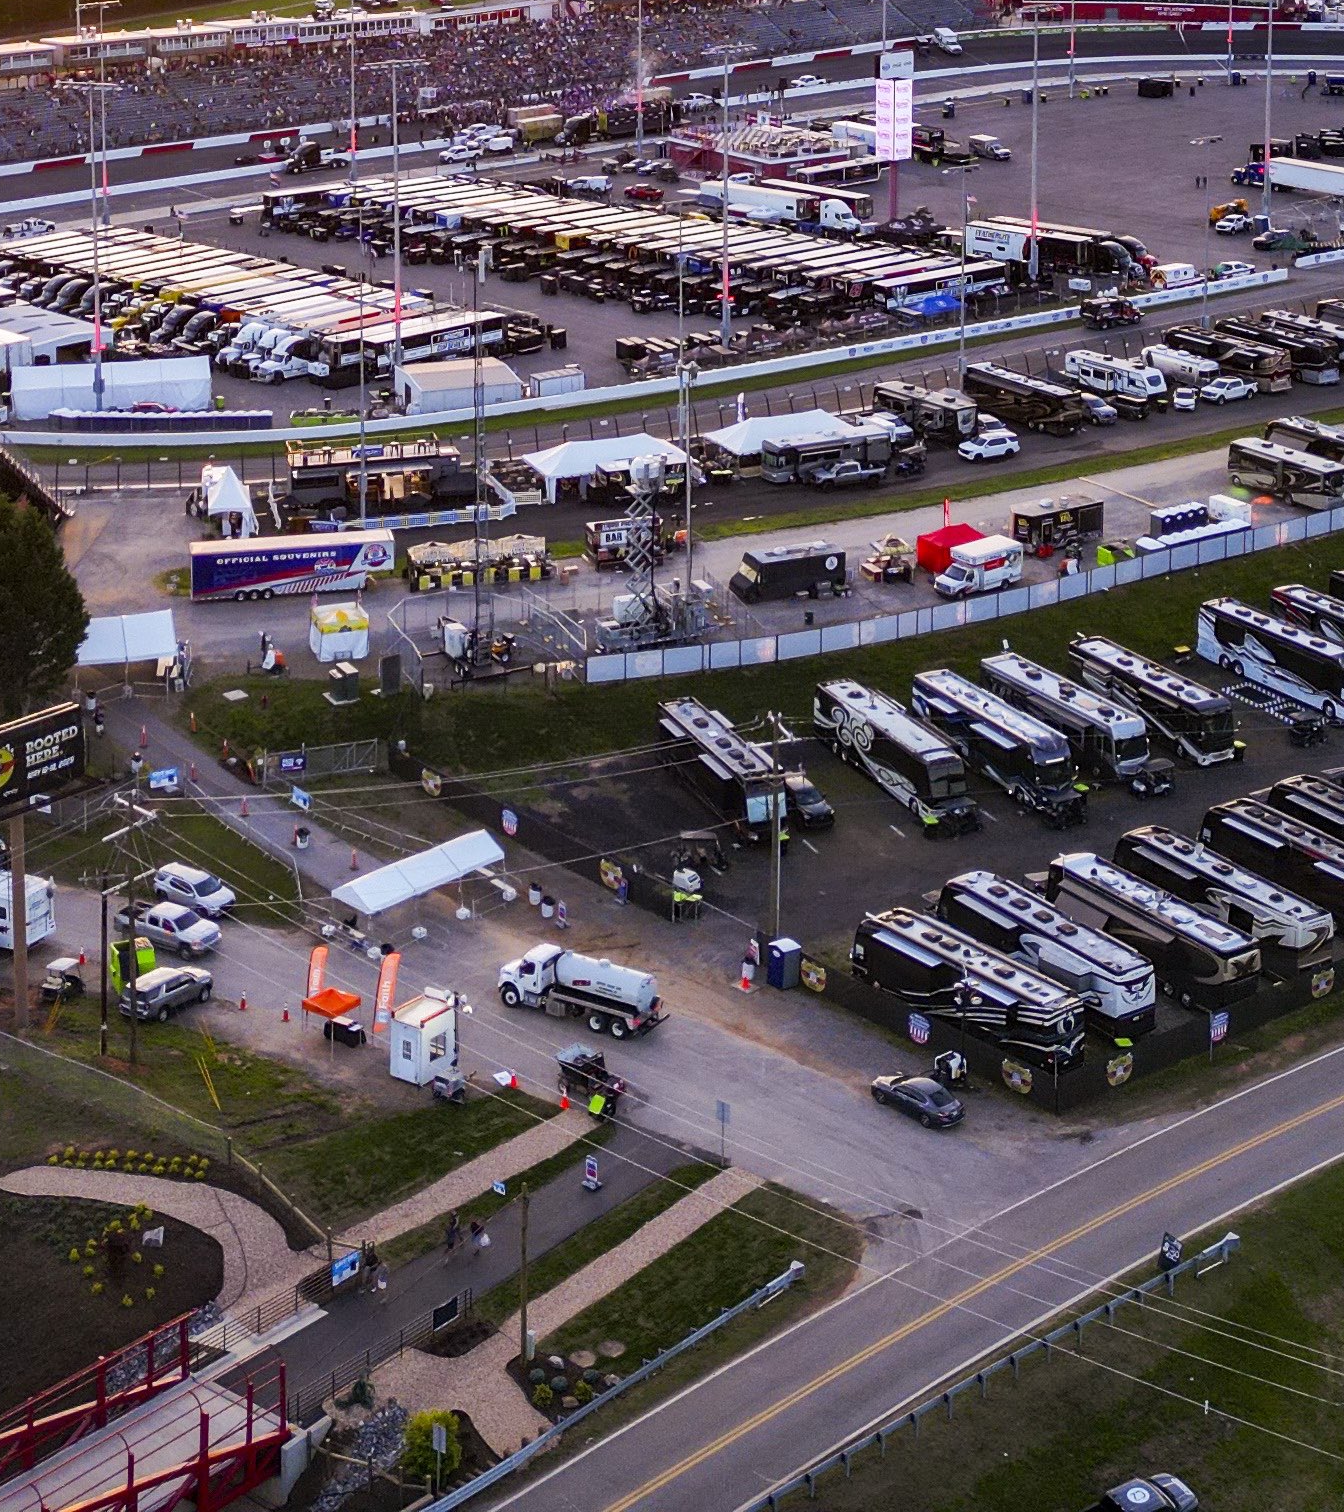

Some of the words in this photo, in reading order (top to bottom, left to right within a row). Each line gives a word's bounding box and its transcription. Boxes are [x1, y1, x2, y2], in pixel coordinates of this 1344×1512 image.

[605, 532, 623, 542] BAR
[216, 555, 269, 566] OFFICIAL
[272, 550, 337, 561] SOUVENIRS
[25, 725, 78, 754] ROOTED
[379, 980, 392, 1009] Faith
